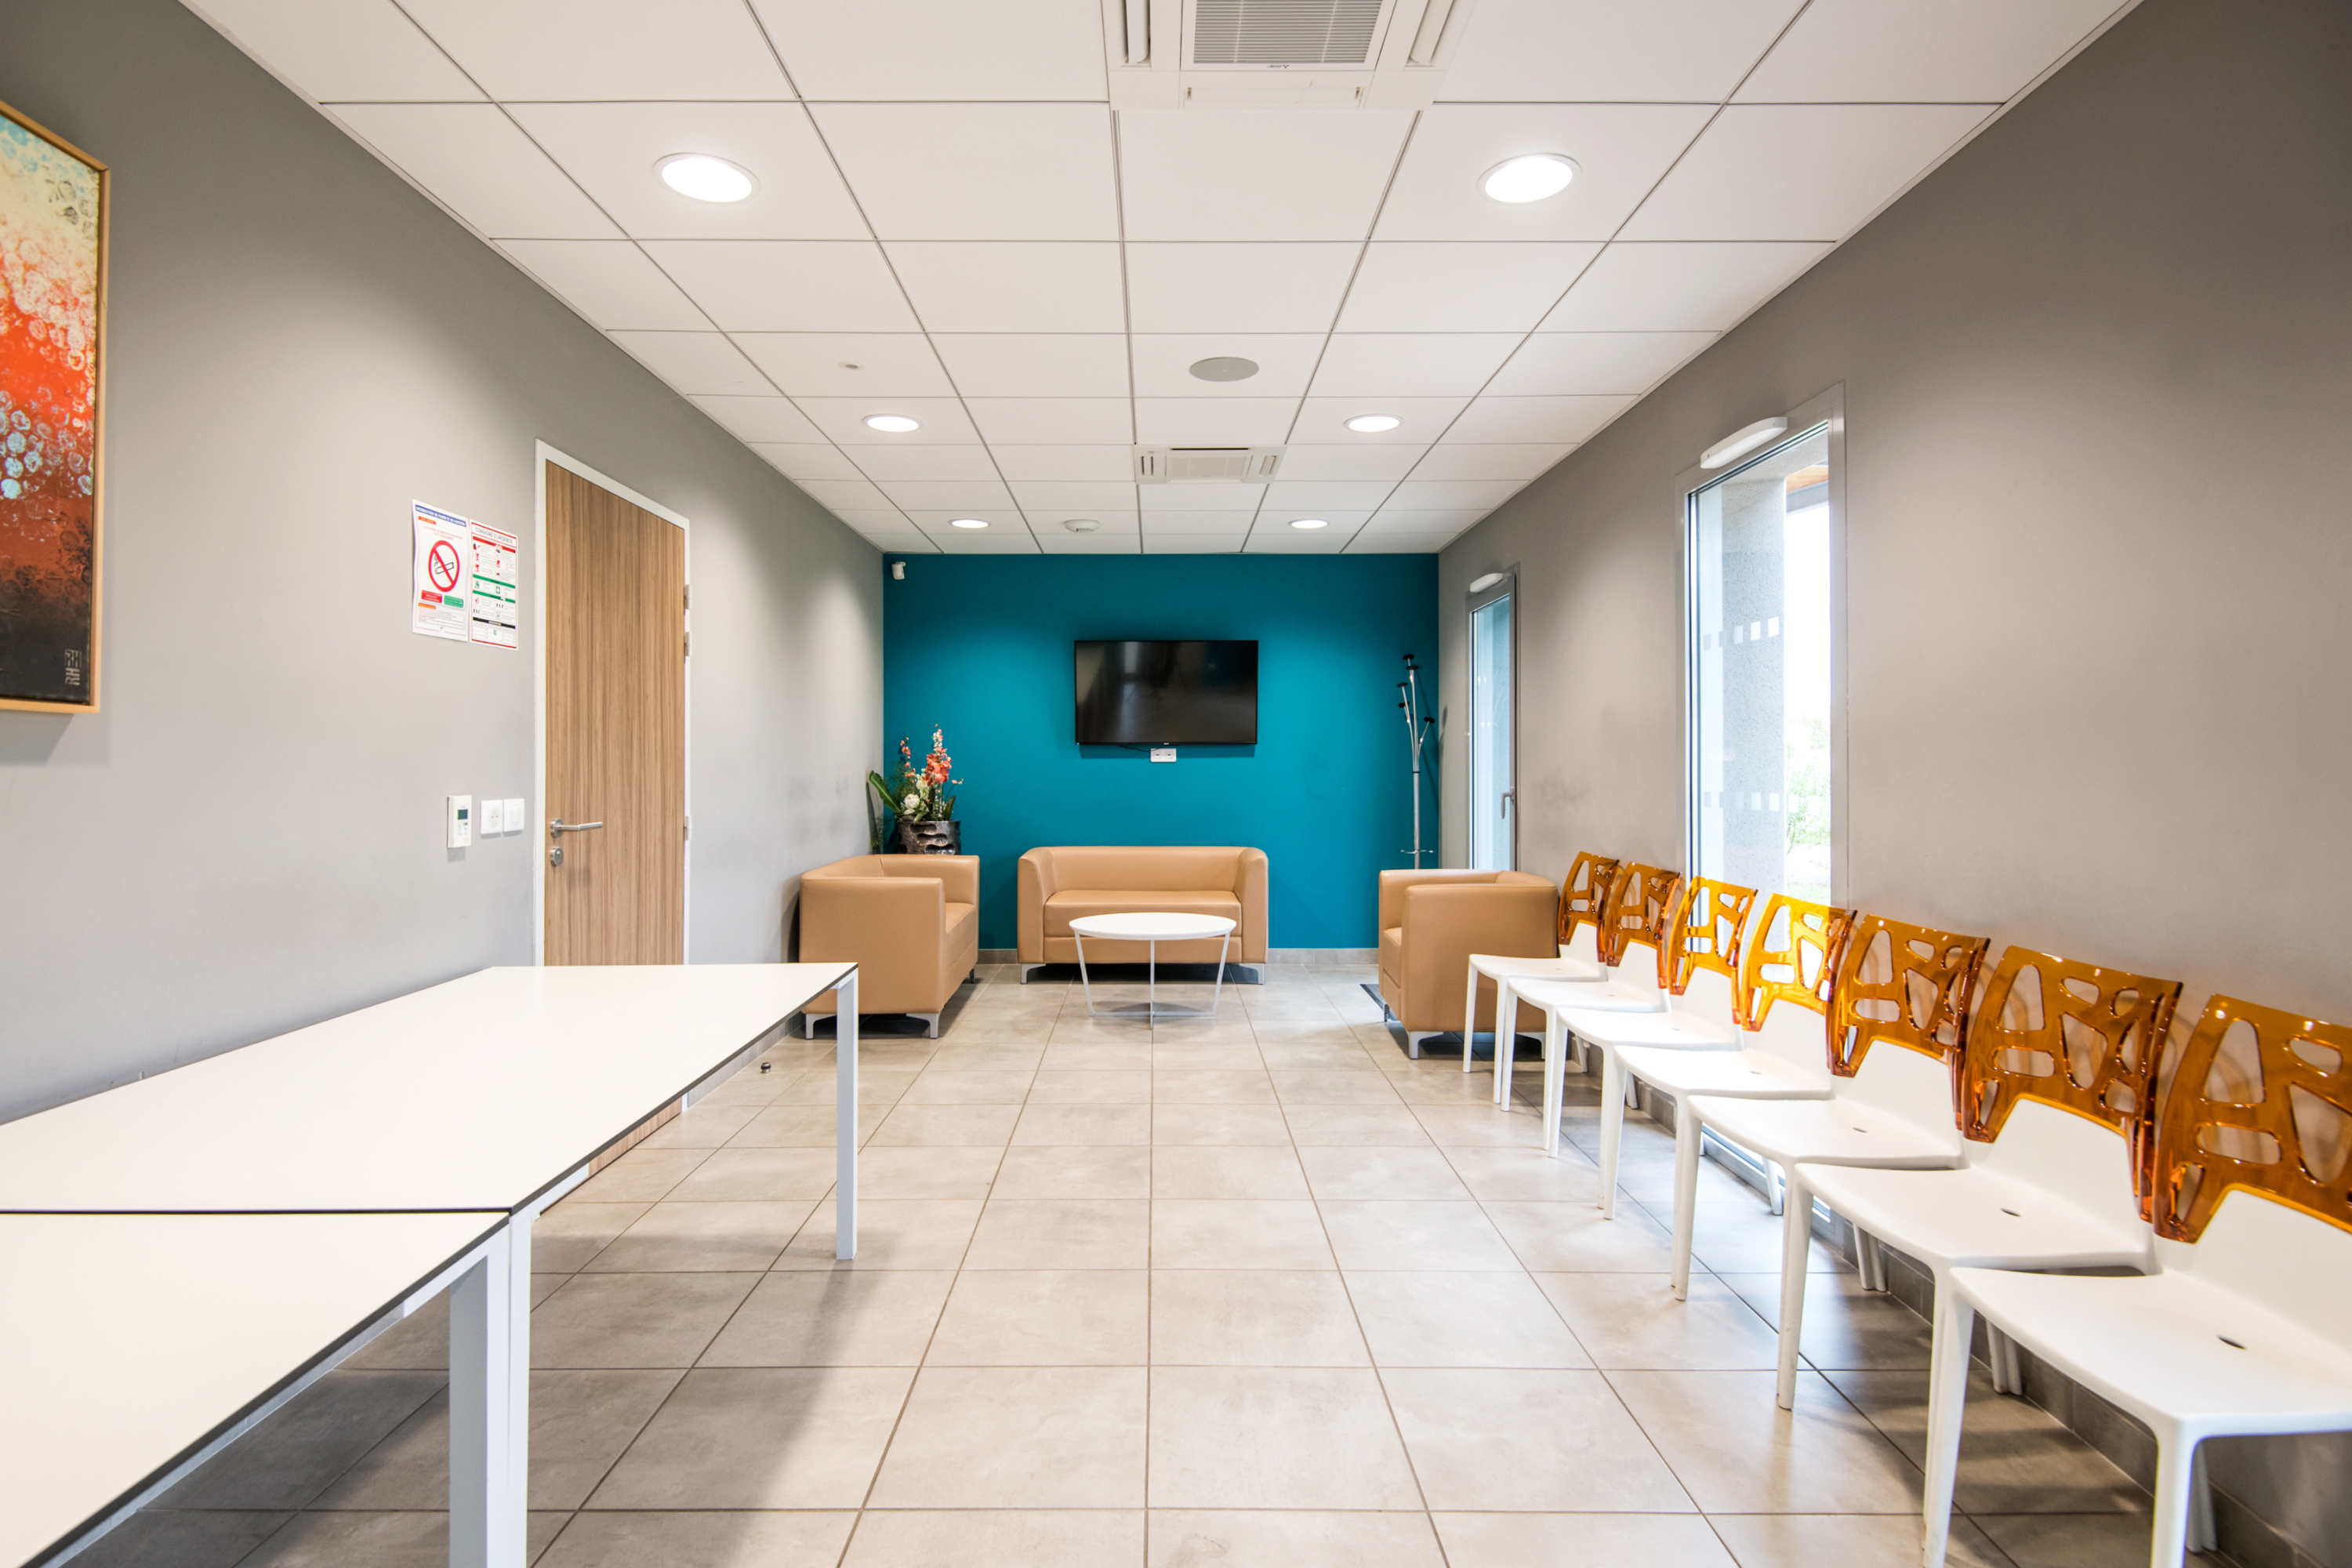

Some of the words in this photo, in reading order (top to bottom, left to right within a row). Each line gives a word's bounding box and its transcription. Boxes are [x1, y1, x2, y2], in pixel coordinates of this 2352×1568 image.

[475, 527, 492, 538] CONSIGNE
[493, 533, 513, 544] D'URGENCE
[65, 667, 80, 686] RH
